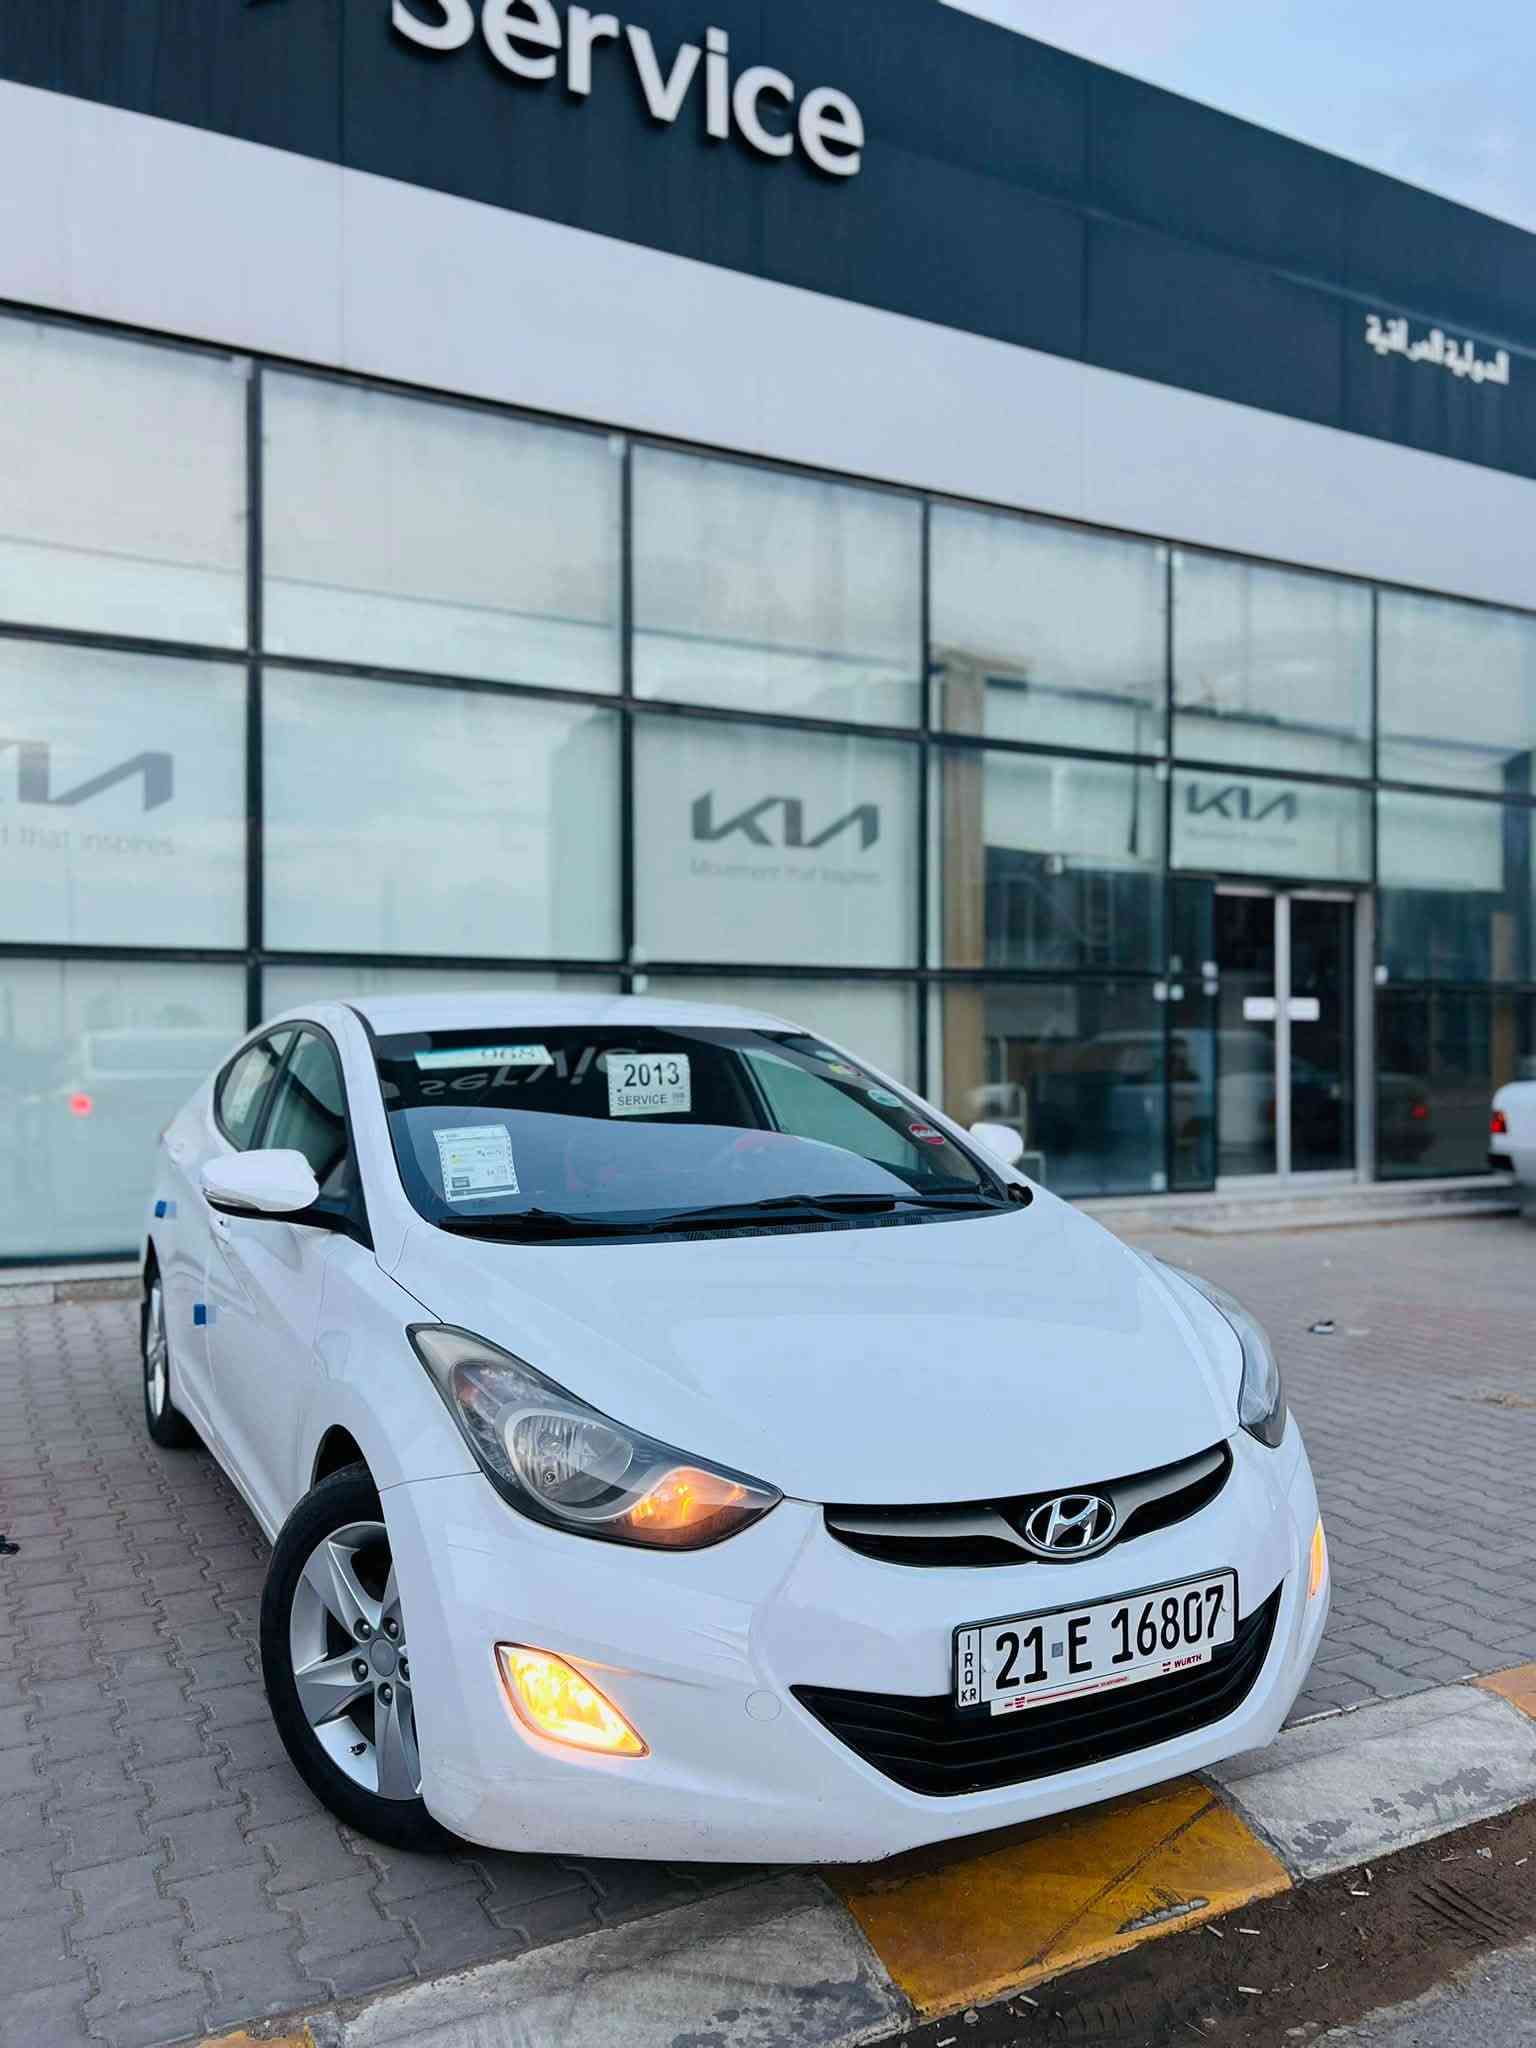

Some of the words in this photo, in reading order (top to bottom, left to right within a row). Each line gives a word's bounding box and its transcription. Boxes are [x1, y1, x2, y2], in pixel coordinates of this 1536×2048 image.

[0, 738, 173, 812] IA
[692, 789, 878, 851] KIA
[623, 1062, 680, 1087] 2013
[616, 1094, 668, 1106] SERVICE
[996, 1625, 1048, 1690] 21
[1068, 1615, 1093, 1675] E
[1111, 1584, 1224, 1665] 16807
[961, 1687, 977, 1702] KR
